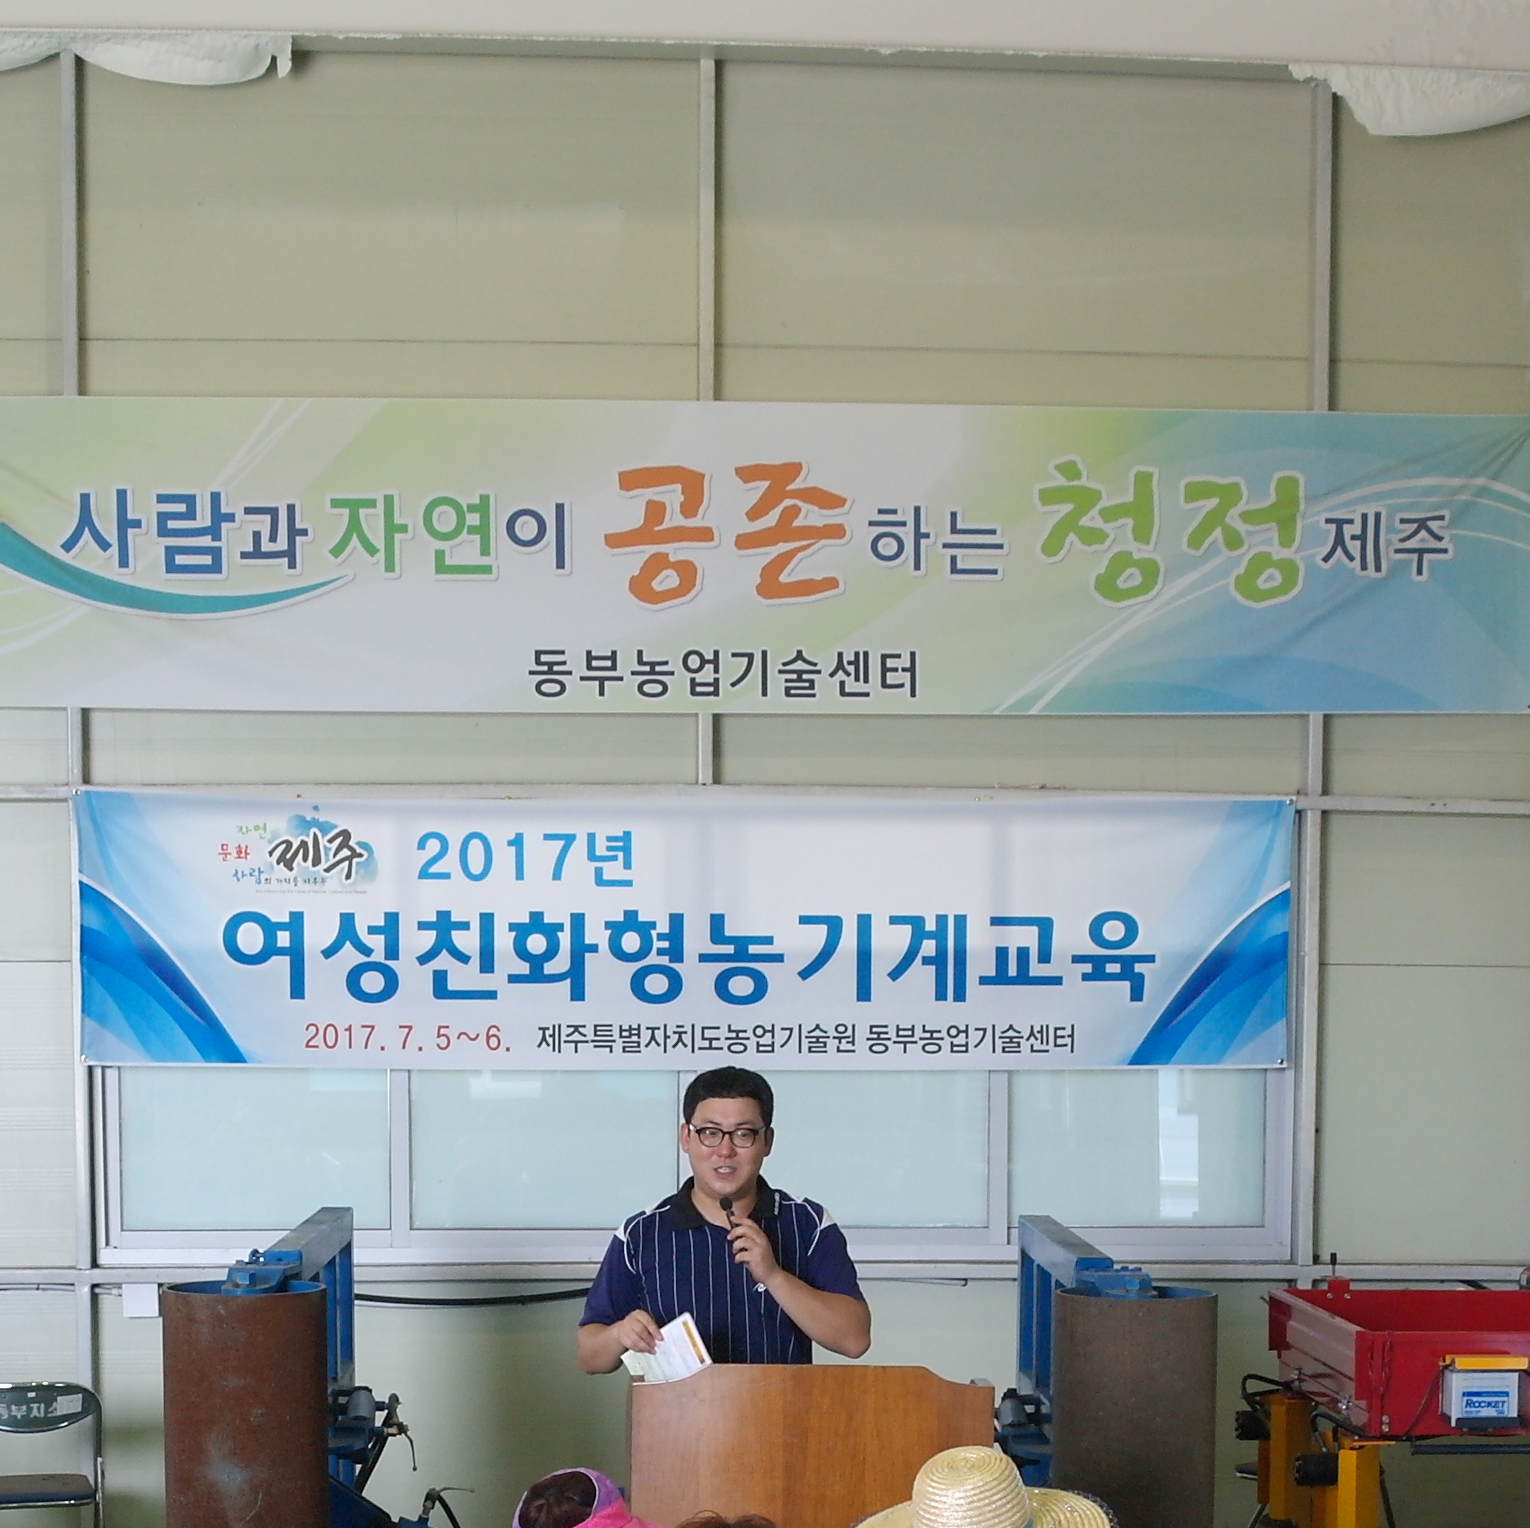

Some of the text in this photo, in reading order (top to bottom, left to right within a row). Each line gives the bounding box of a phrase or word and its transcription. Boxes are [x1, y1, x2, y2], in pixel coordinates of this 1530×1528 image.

[59, 488, 309, 576] 사람과
[328, 492, 568, 576] 자연이
[603, 464, 1005, 603] 공존하는
[529, 649, 919, 699] 동부농업기술센터
[218, 842, 251, 862] 문화
[268, 828, 634, 888] 제주 2017년
[222, 908, 1158, 1007] 여성친화형농기계교육
[304, 1023, 386, 1053] 2017.
[398, 1023, 424, 1053] 7.
[536, 1022, 856, 1056] 제주특별자치도농업기술원
[867, 1022, 1076, 1056] 동부농업기술센터
[1465, 1398, 1507, 1409] ROCKET
